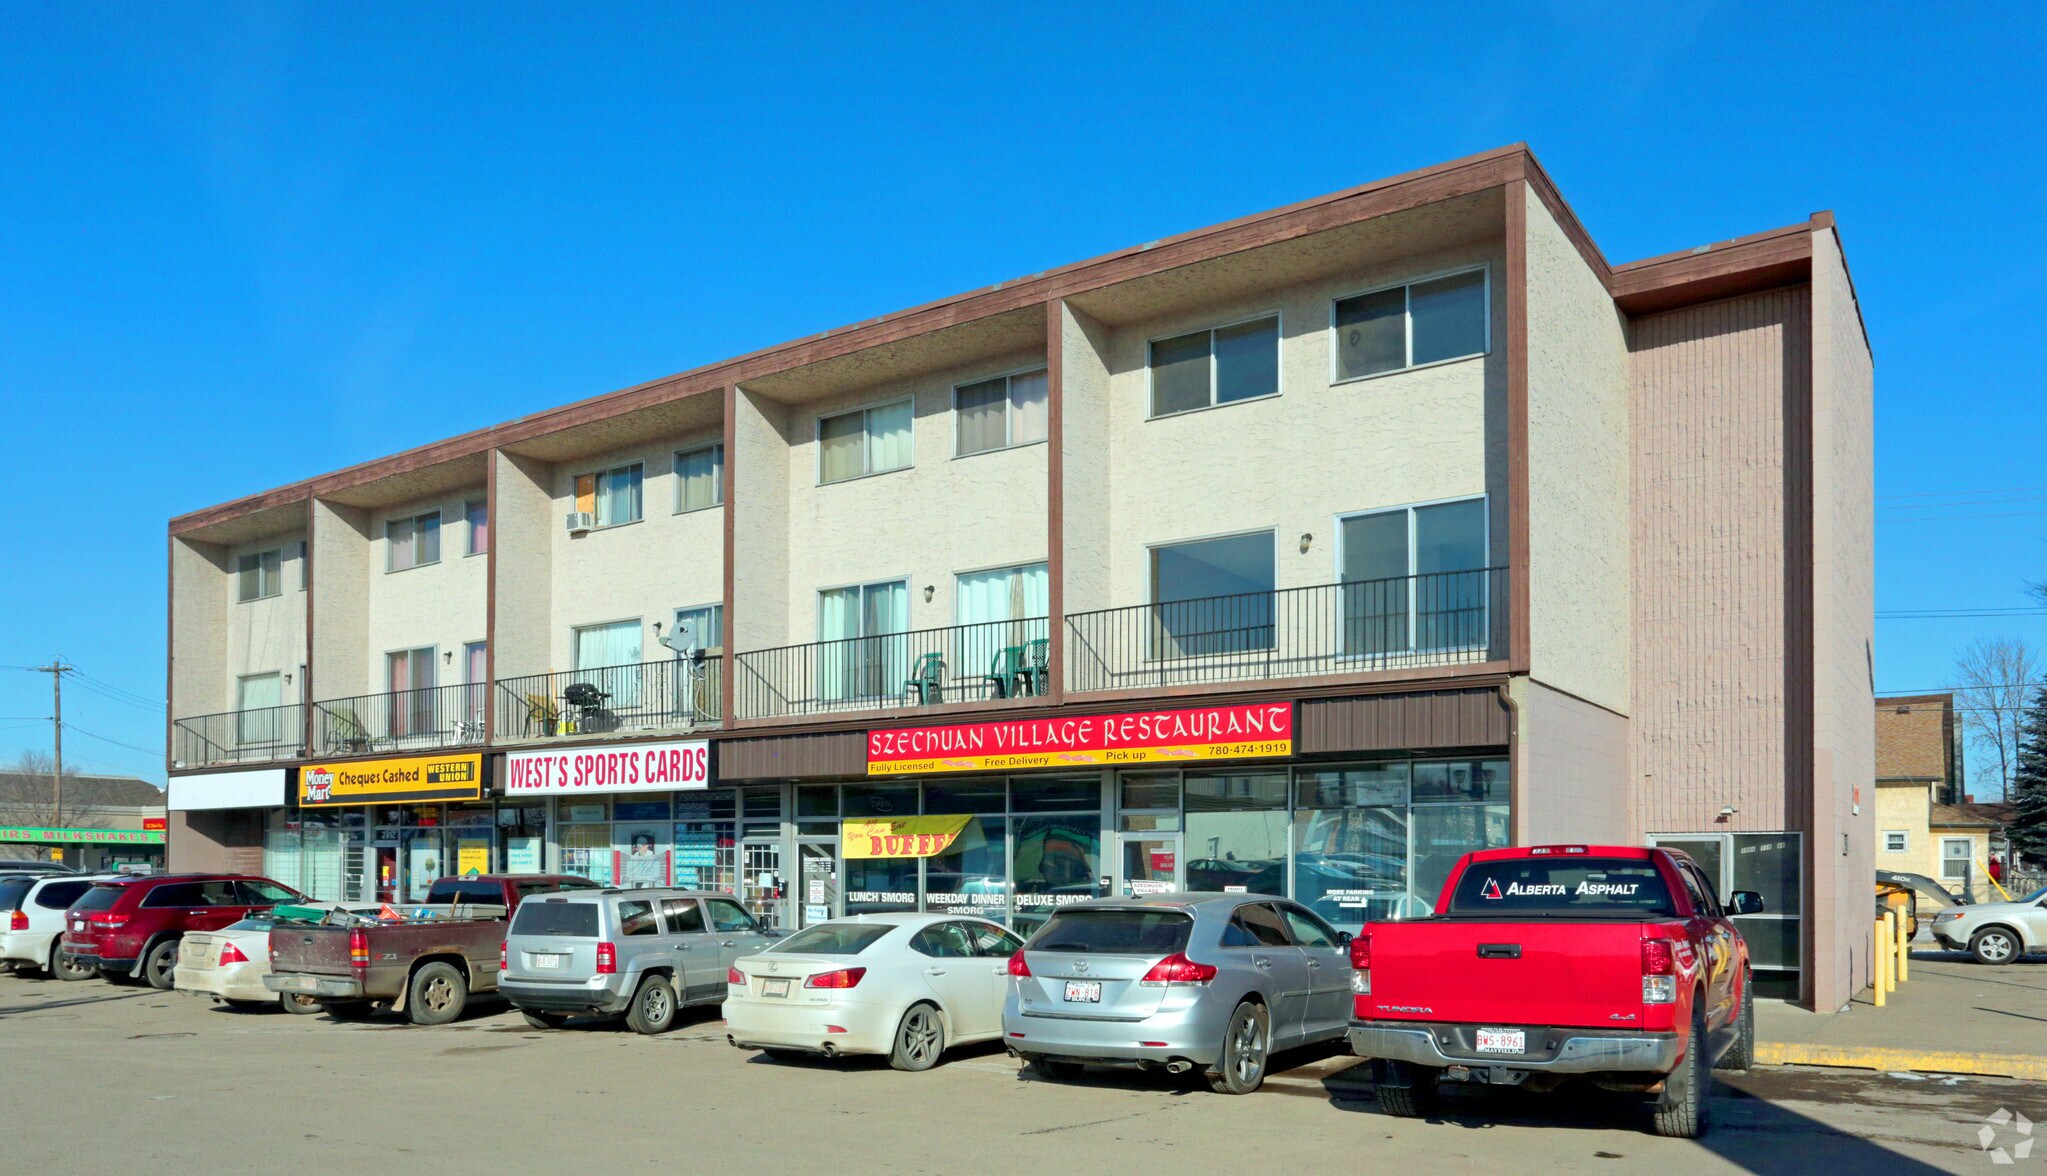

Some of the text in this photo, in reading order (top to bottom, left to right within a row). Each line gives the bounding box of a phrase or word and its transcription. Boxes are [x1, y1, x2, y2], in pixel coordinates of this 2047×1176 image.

[870, 706, 1288, 757] SZECHUAN VILLAGE RESTAURANT
[870, 742, 1287, 773] Fully Licensed Free Delivery Pick up 780-474-1919
[427, 762, 467, 774] WESTERN
[510, 747, 706, 790] WEST'S SPORTS CARDS
[305, 768, 335, 788] Money
[339, 767, 419, 787] Cheques Cashed
[439, 772, 467, 782] UNION
[306, 785, 330, 801] Mart
[847, 822, 906, 841] You Can Eat
[1891, 875, 1911, 883] 410K
[849, 892, 914, 903] LUNCH SMORG
[927, 893, 1005, 905] WEEKDAY DINNER
[1017, 895, 1053, 906] DELUXE
[947, 907, 984, 915] SMORG
[1377, 1005, 1432, 1014] TUNDRA
